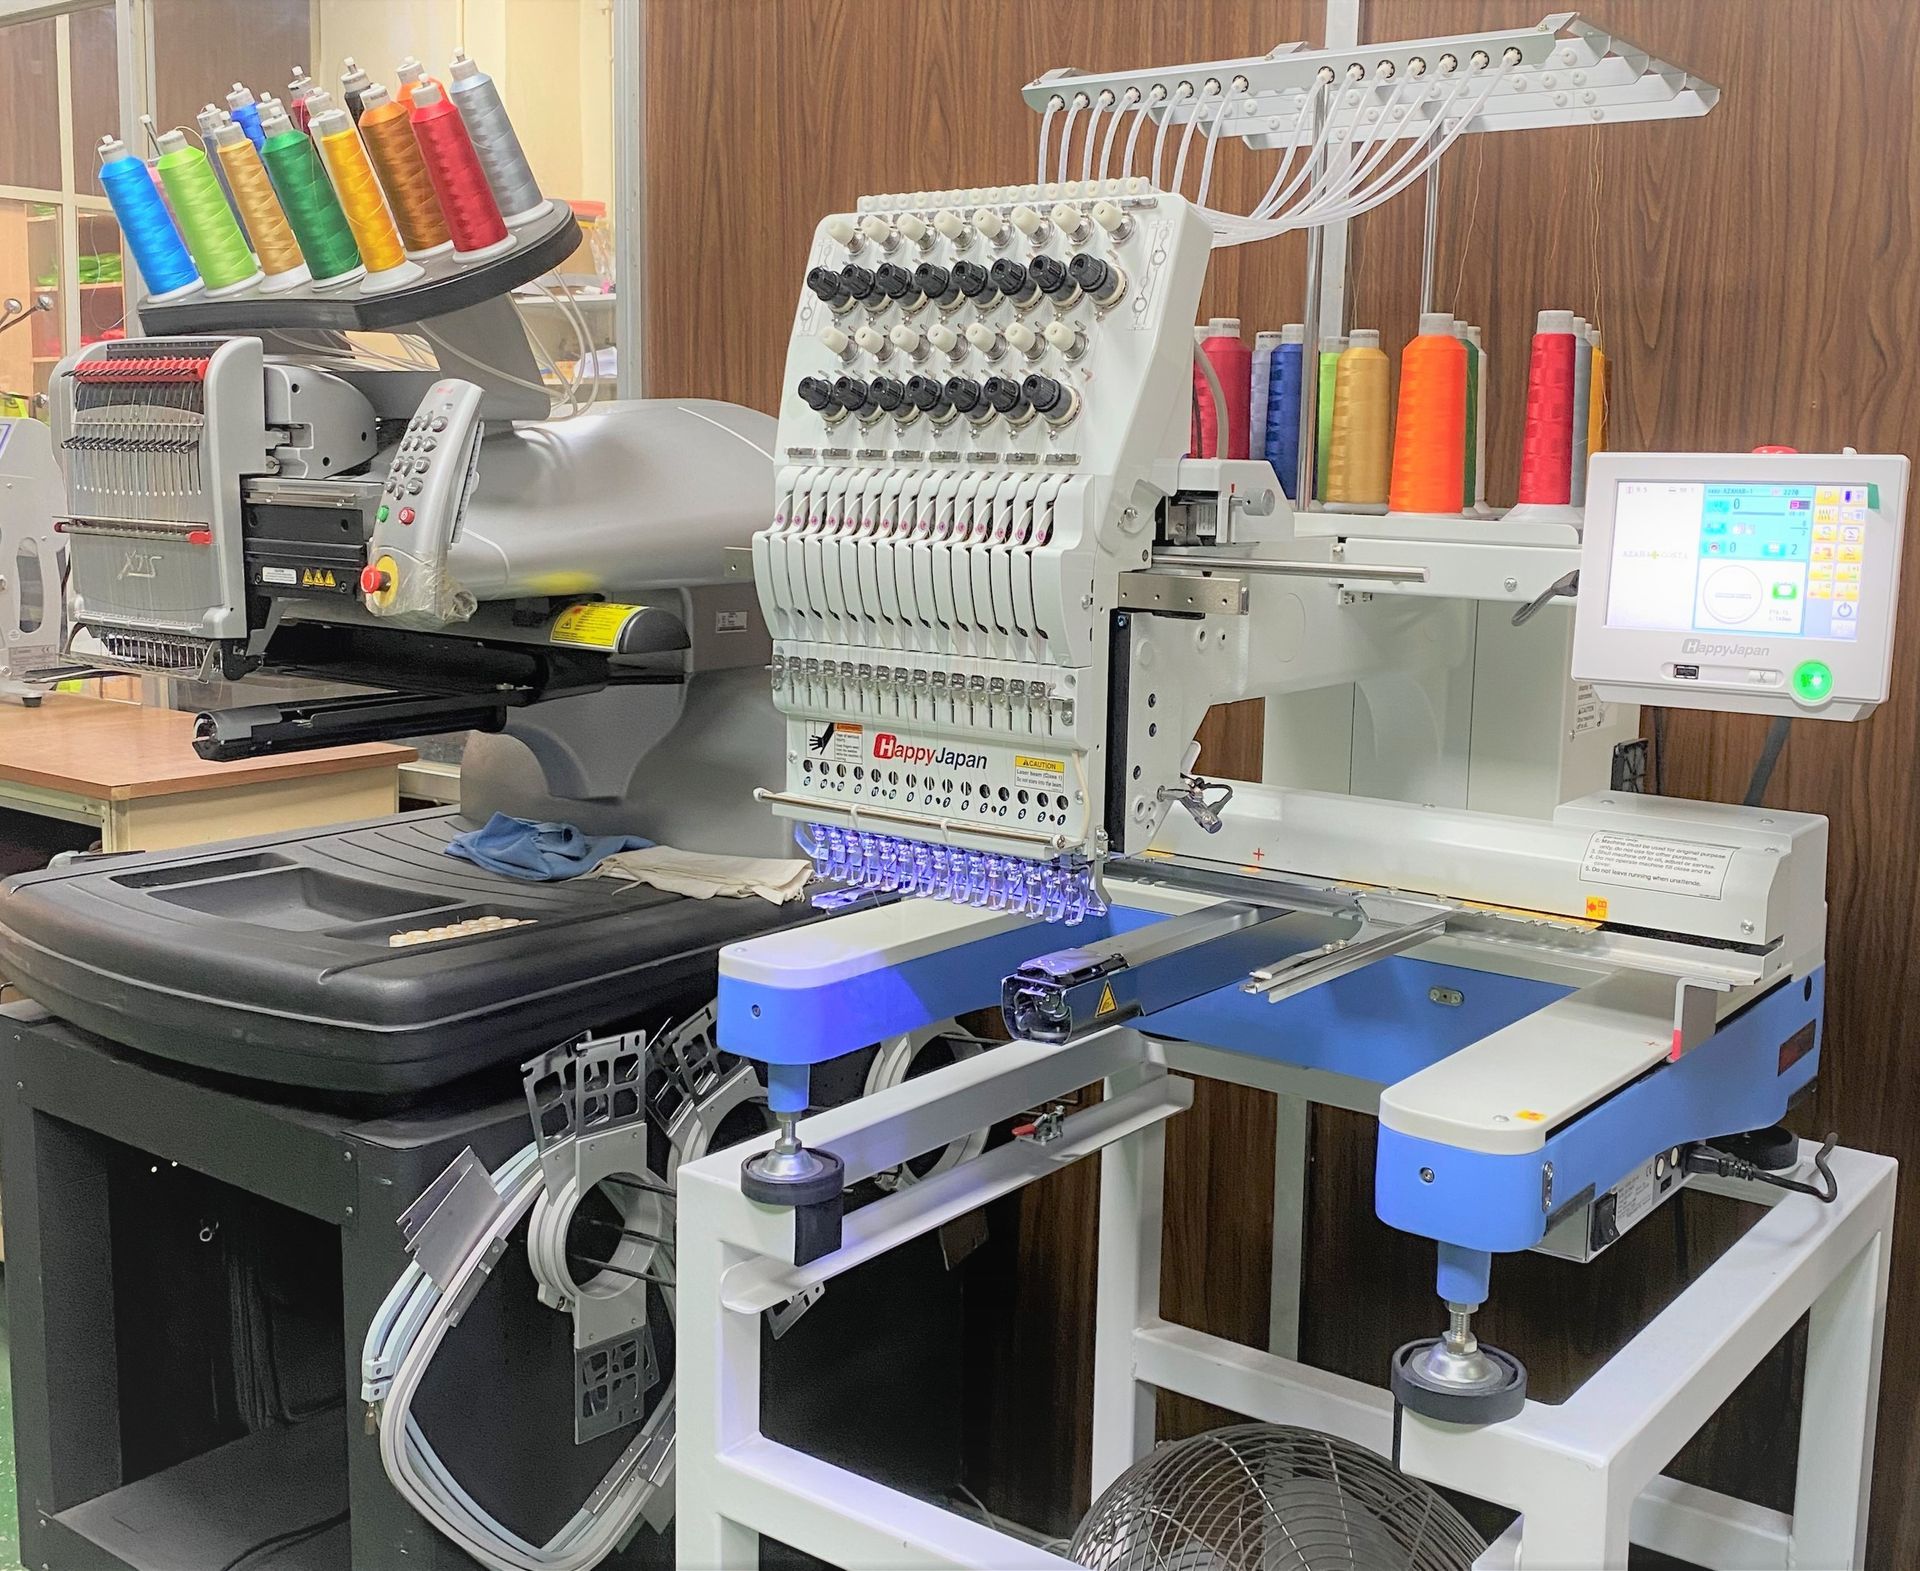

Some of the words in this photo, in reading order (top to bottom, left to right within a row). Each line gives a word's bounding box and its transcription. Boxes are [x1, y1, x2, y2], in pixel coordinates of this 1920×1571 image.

[1791, 544, 1798, 555] 2
[1681, 638, 1770, 657] HappyJapan
[873, 733, 988, 770] HappyJapan
[1029, 760, 1057, 770] CAUTION
[1628, 872, 1651, 881] running
